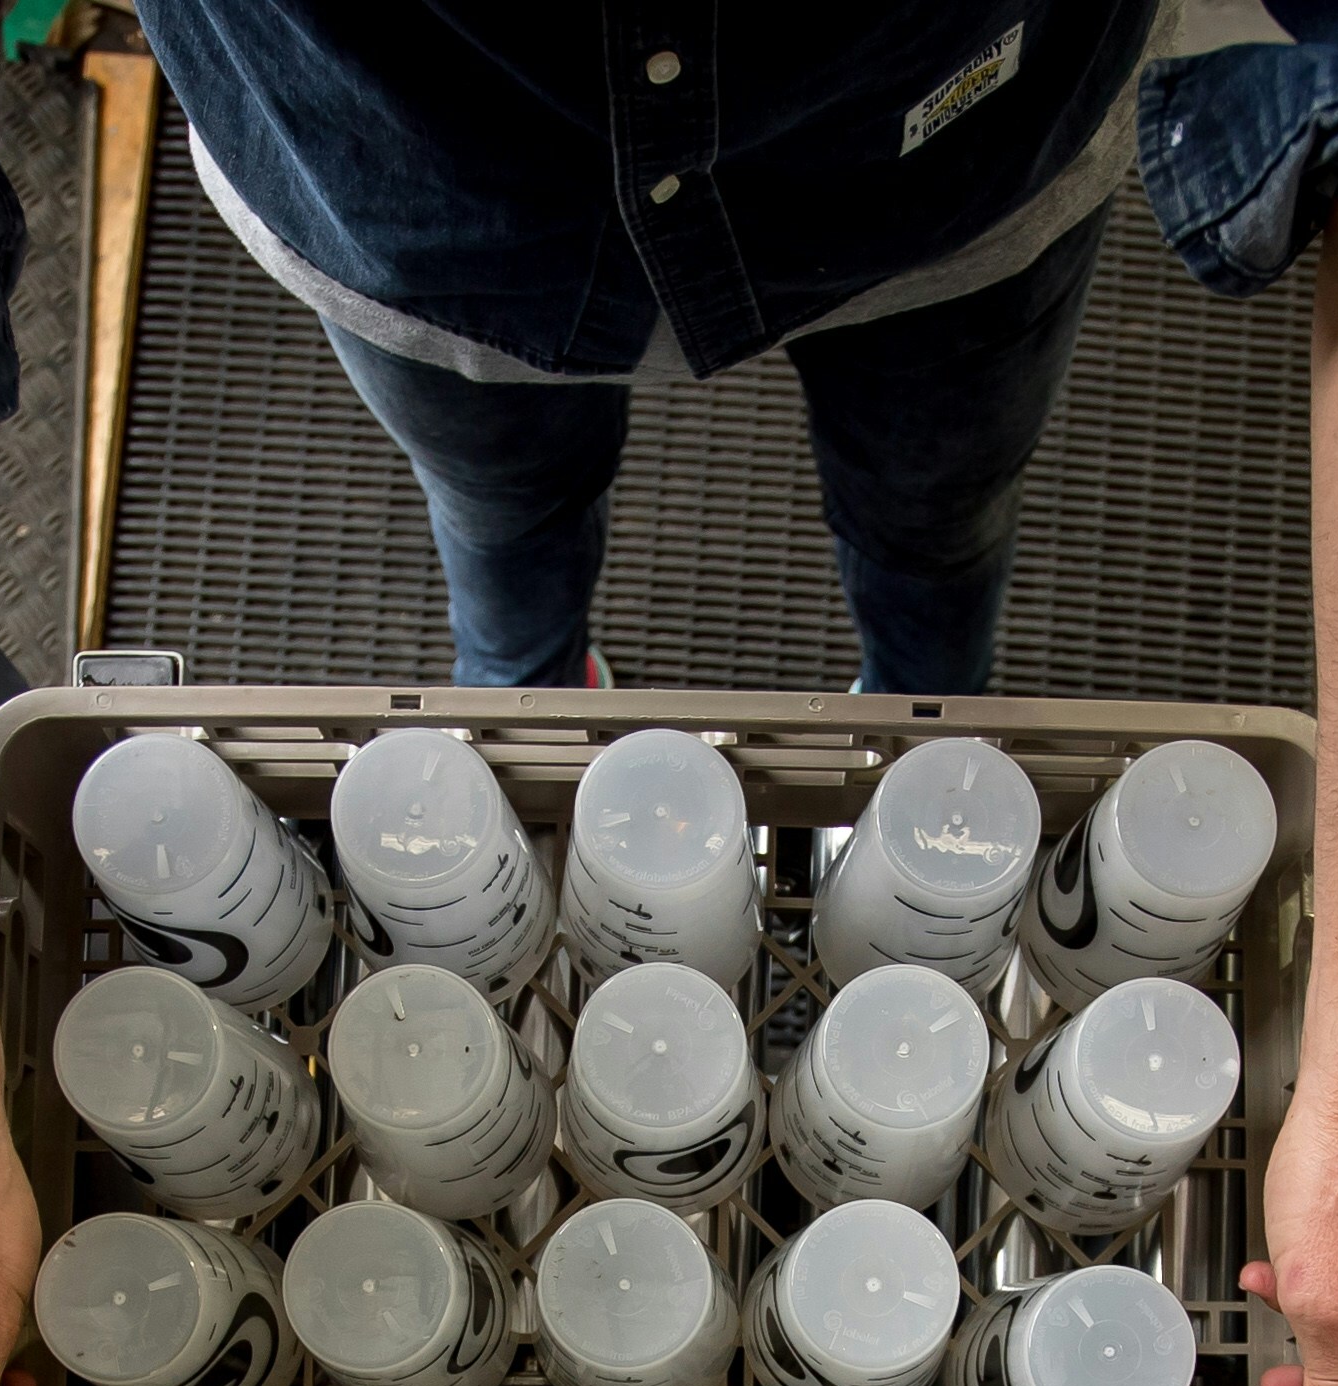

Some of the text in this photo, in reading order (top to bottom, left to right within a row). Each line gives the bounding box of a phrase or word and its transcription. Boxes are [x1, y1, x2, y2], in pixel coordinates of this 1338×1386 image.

[828, 1019, 843, 1046] BPA
[857, 1097, 875, 1113] ml
[964, 1058, 979, 1078] NZ
